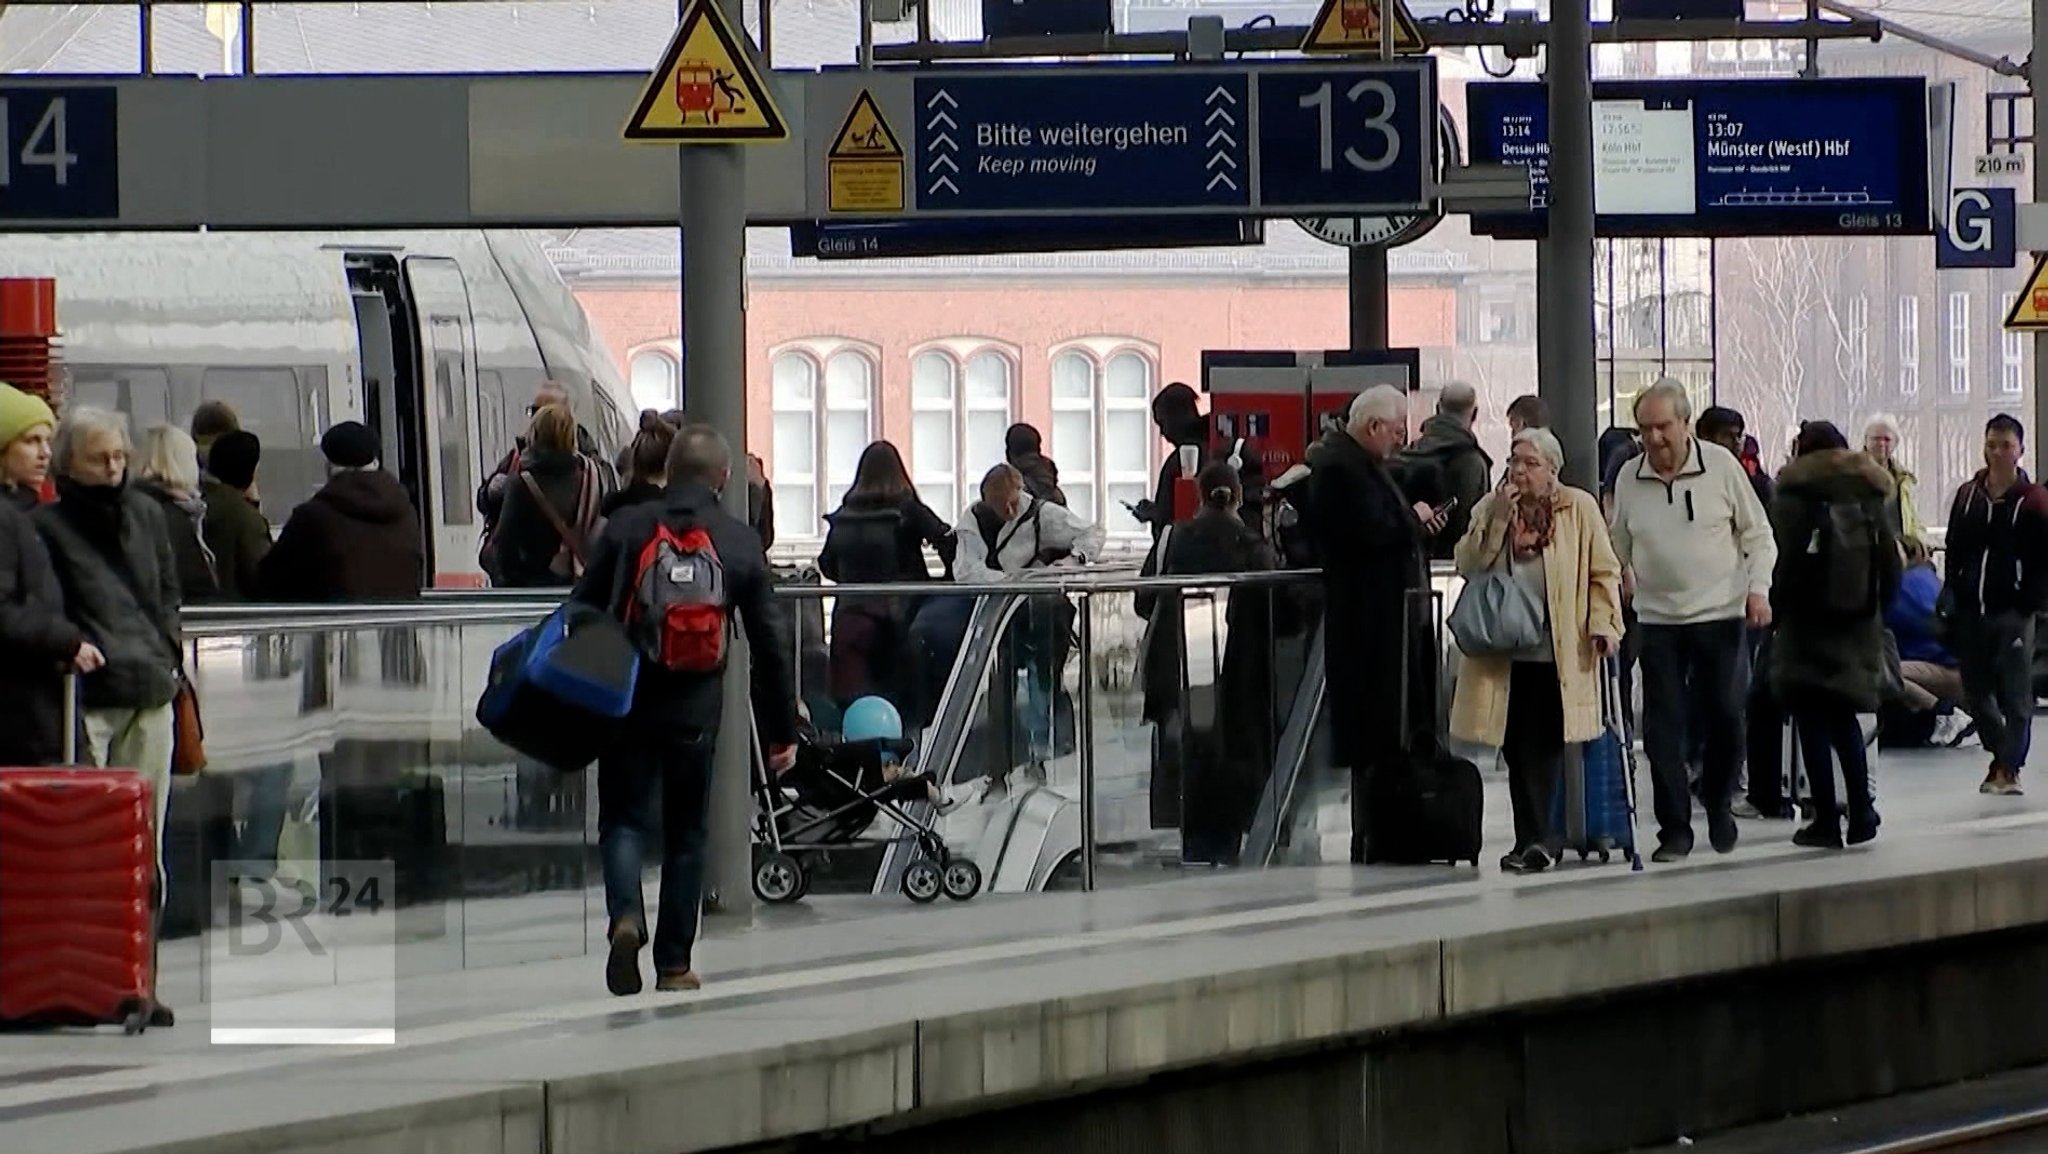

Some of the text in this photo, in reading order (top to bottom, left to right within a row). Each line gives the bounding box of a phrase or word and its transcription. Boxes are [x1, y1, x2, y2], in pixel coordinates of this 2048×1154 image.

[1299, 79, 1400, 172] 13
[1502, 125, 1531, 137] 13:14
[1708, 122, 1744, 137] 13:07
[976, 121, 1187, 149] Bitte weitergehen
[1502, 142, 1535, 155] Dessau
[1708, 140, 1850, 158] Münster (Westf) Hbf
[978, 154, 1096, 176] Keep moving
[1978, 158, 2021, 173] 210 m
[1839, 213, 1902, 228] Gleis 13
[1948, 190, 1991, 251] G
[818, 237, 879, 253] Gleis 14
